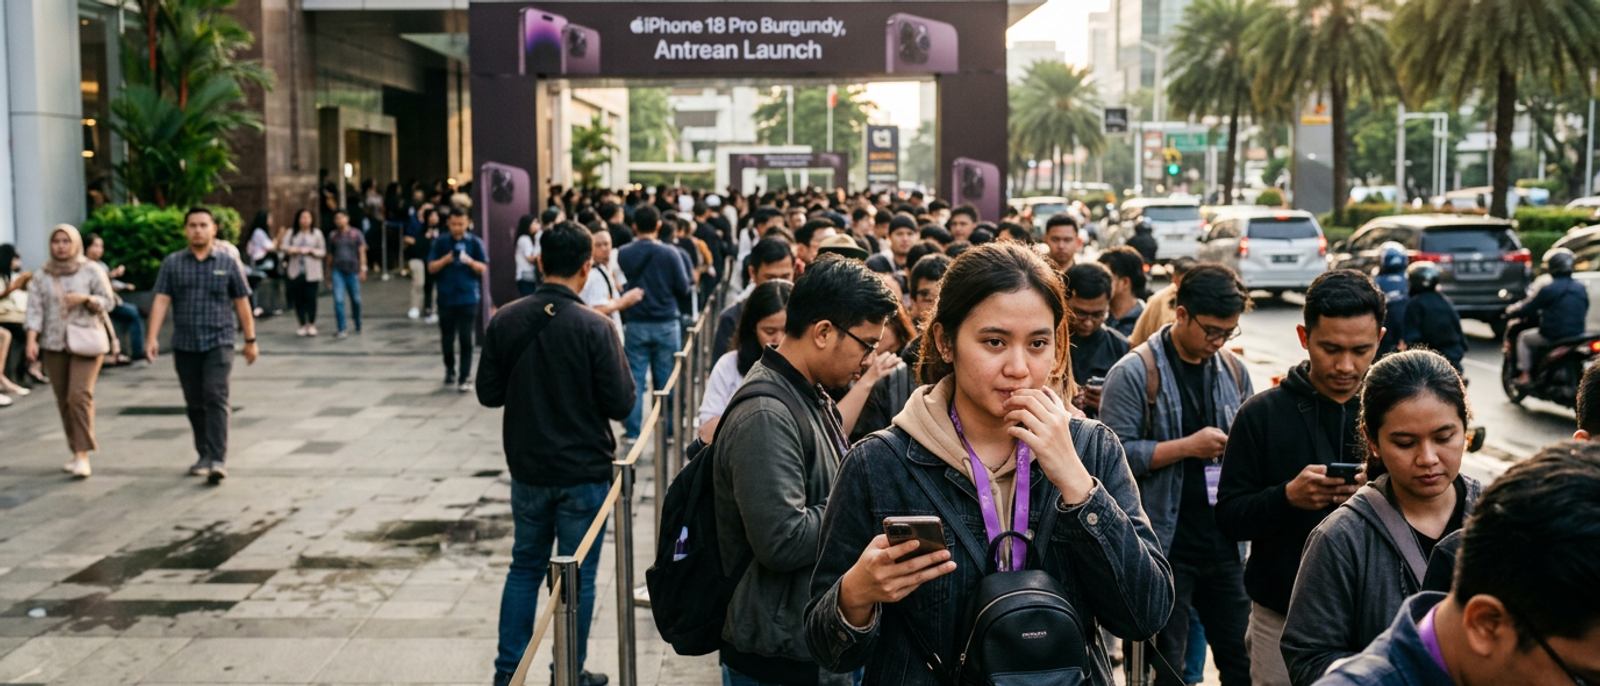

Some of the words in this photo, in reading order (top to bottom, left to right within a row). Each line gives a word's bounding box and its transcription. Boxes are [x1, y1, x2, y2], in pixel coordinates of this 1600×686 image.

[644, 17, 703, 34] iPhone
[705, 17, 726, 34] 18
[728, 17, 758, 34] Pro
[760, 17, 846, 37] Burgundy,
[654, 39, 739, 60] Antrean
[743, 39, 822, 60] Launch
